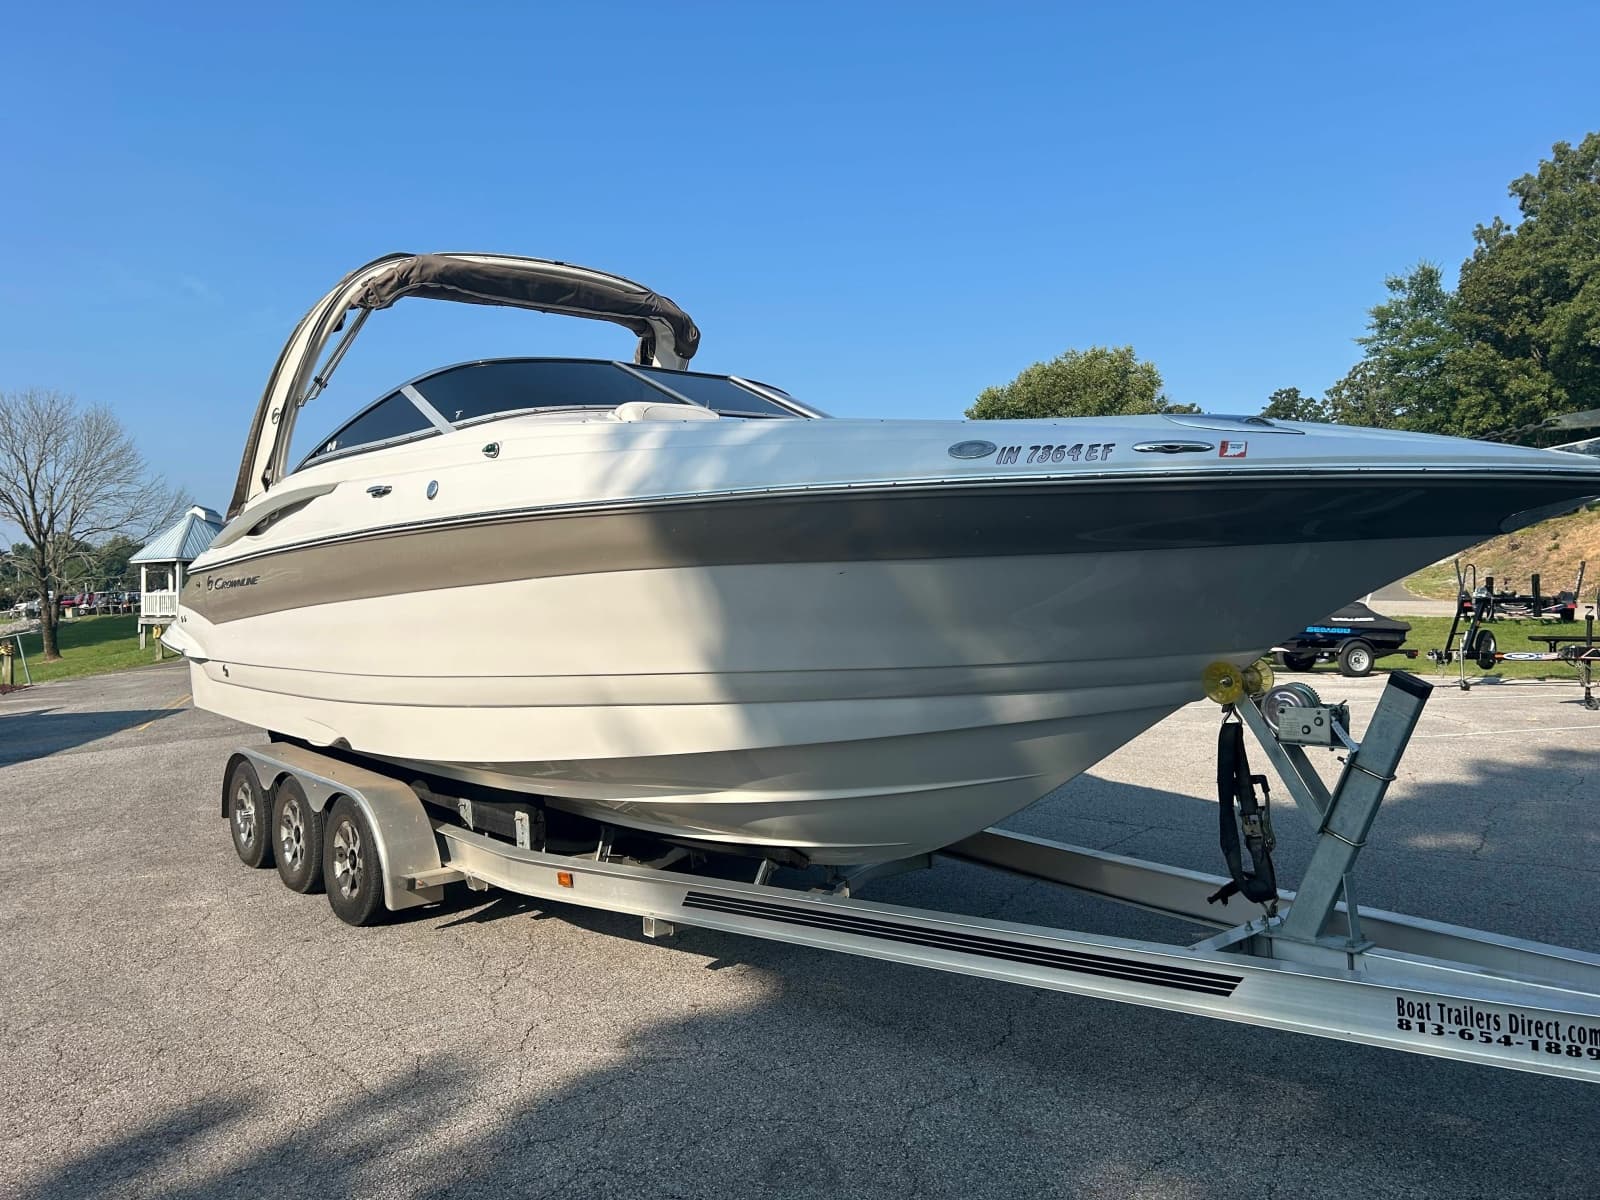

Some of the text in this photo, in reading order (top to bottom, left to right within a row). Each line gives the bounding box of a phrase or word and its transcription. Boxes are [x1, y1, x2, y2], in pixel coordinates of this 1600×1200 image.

[996, 446, 1022, 465] IN
[1396, 997, 1600, 1047] Boat Trailers Direct.com
[1397, 1018, 1600, 1060] 813-654-1889
